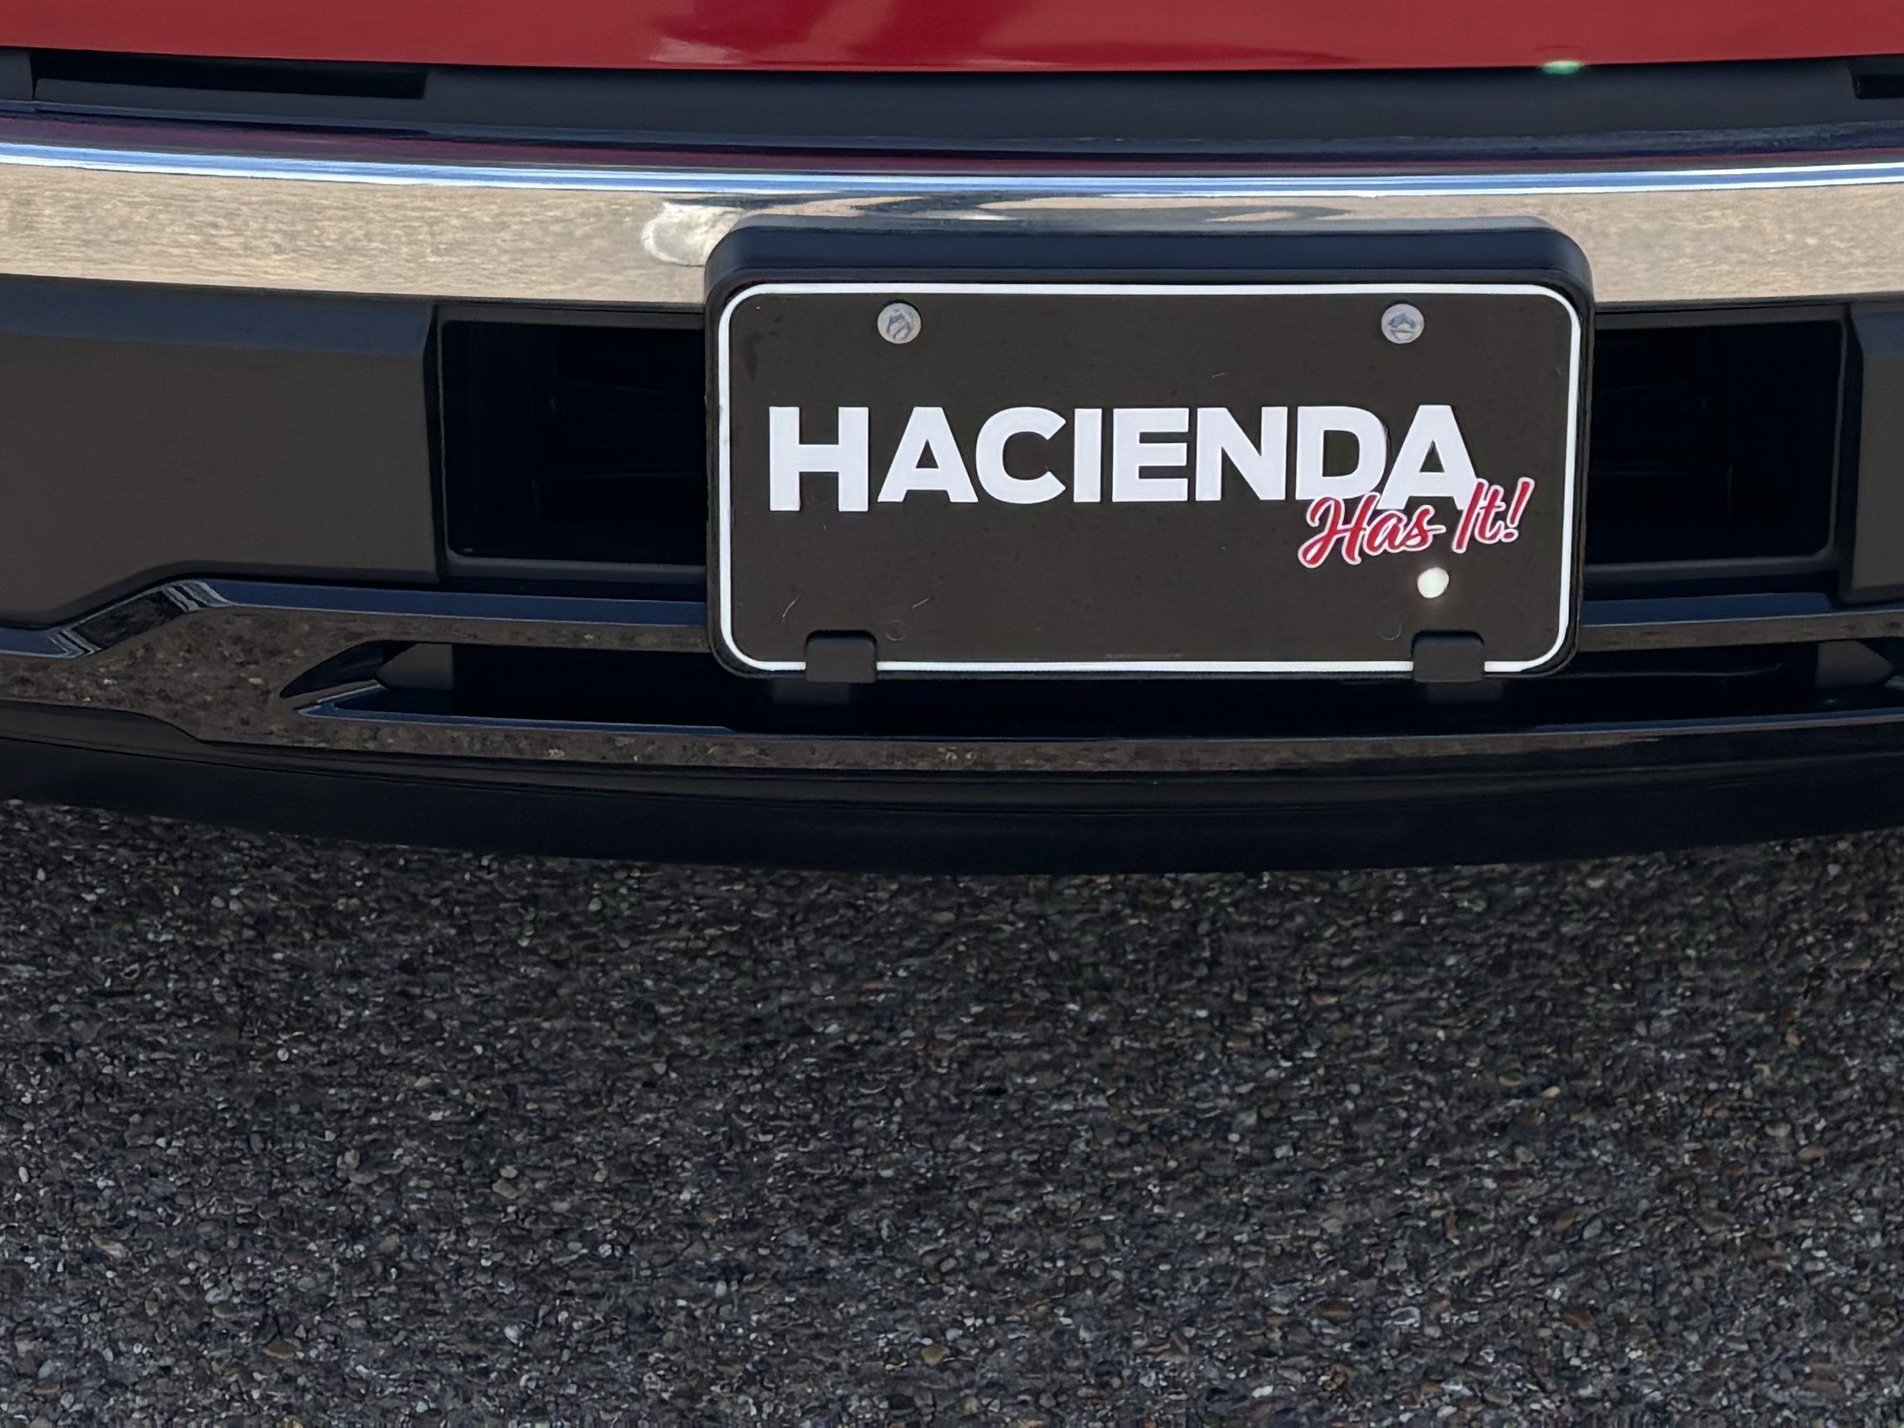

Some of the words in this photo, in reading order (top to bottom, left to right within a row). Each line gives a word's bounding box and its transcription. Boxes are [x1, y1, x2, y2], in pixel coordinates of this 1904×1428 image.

[768, 403, 1484, 513] HACIENDA
[1298, 491, 1447, 569] Has
[1451, 477, 1536, 554] It!
